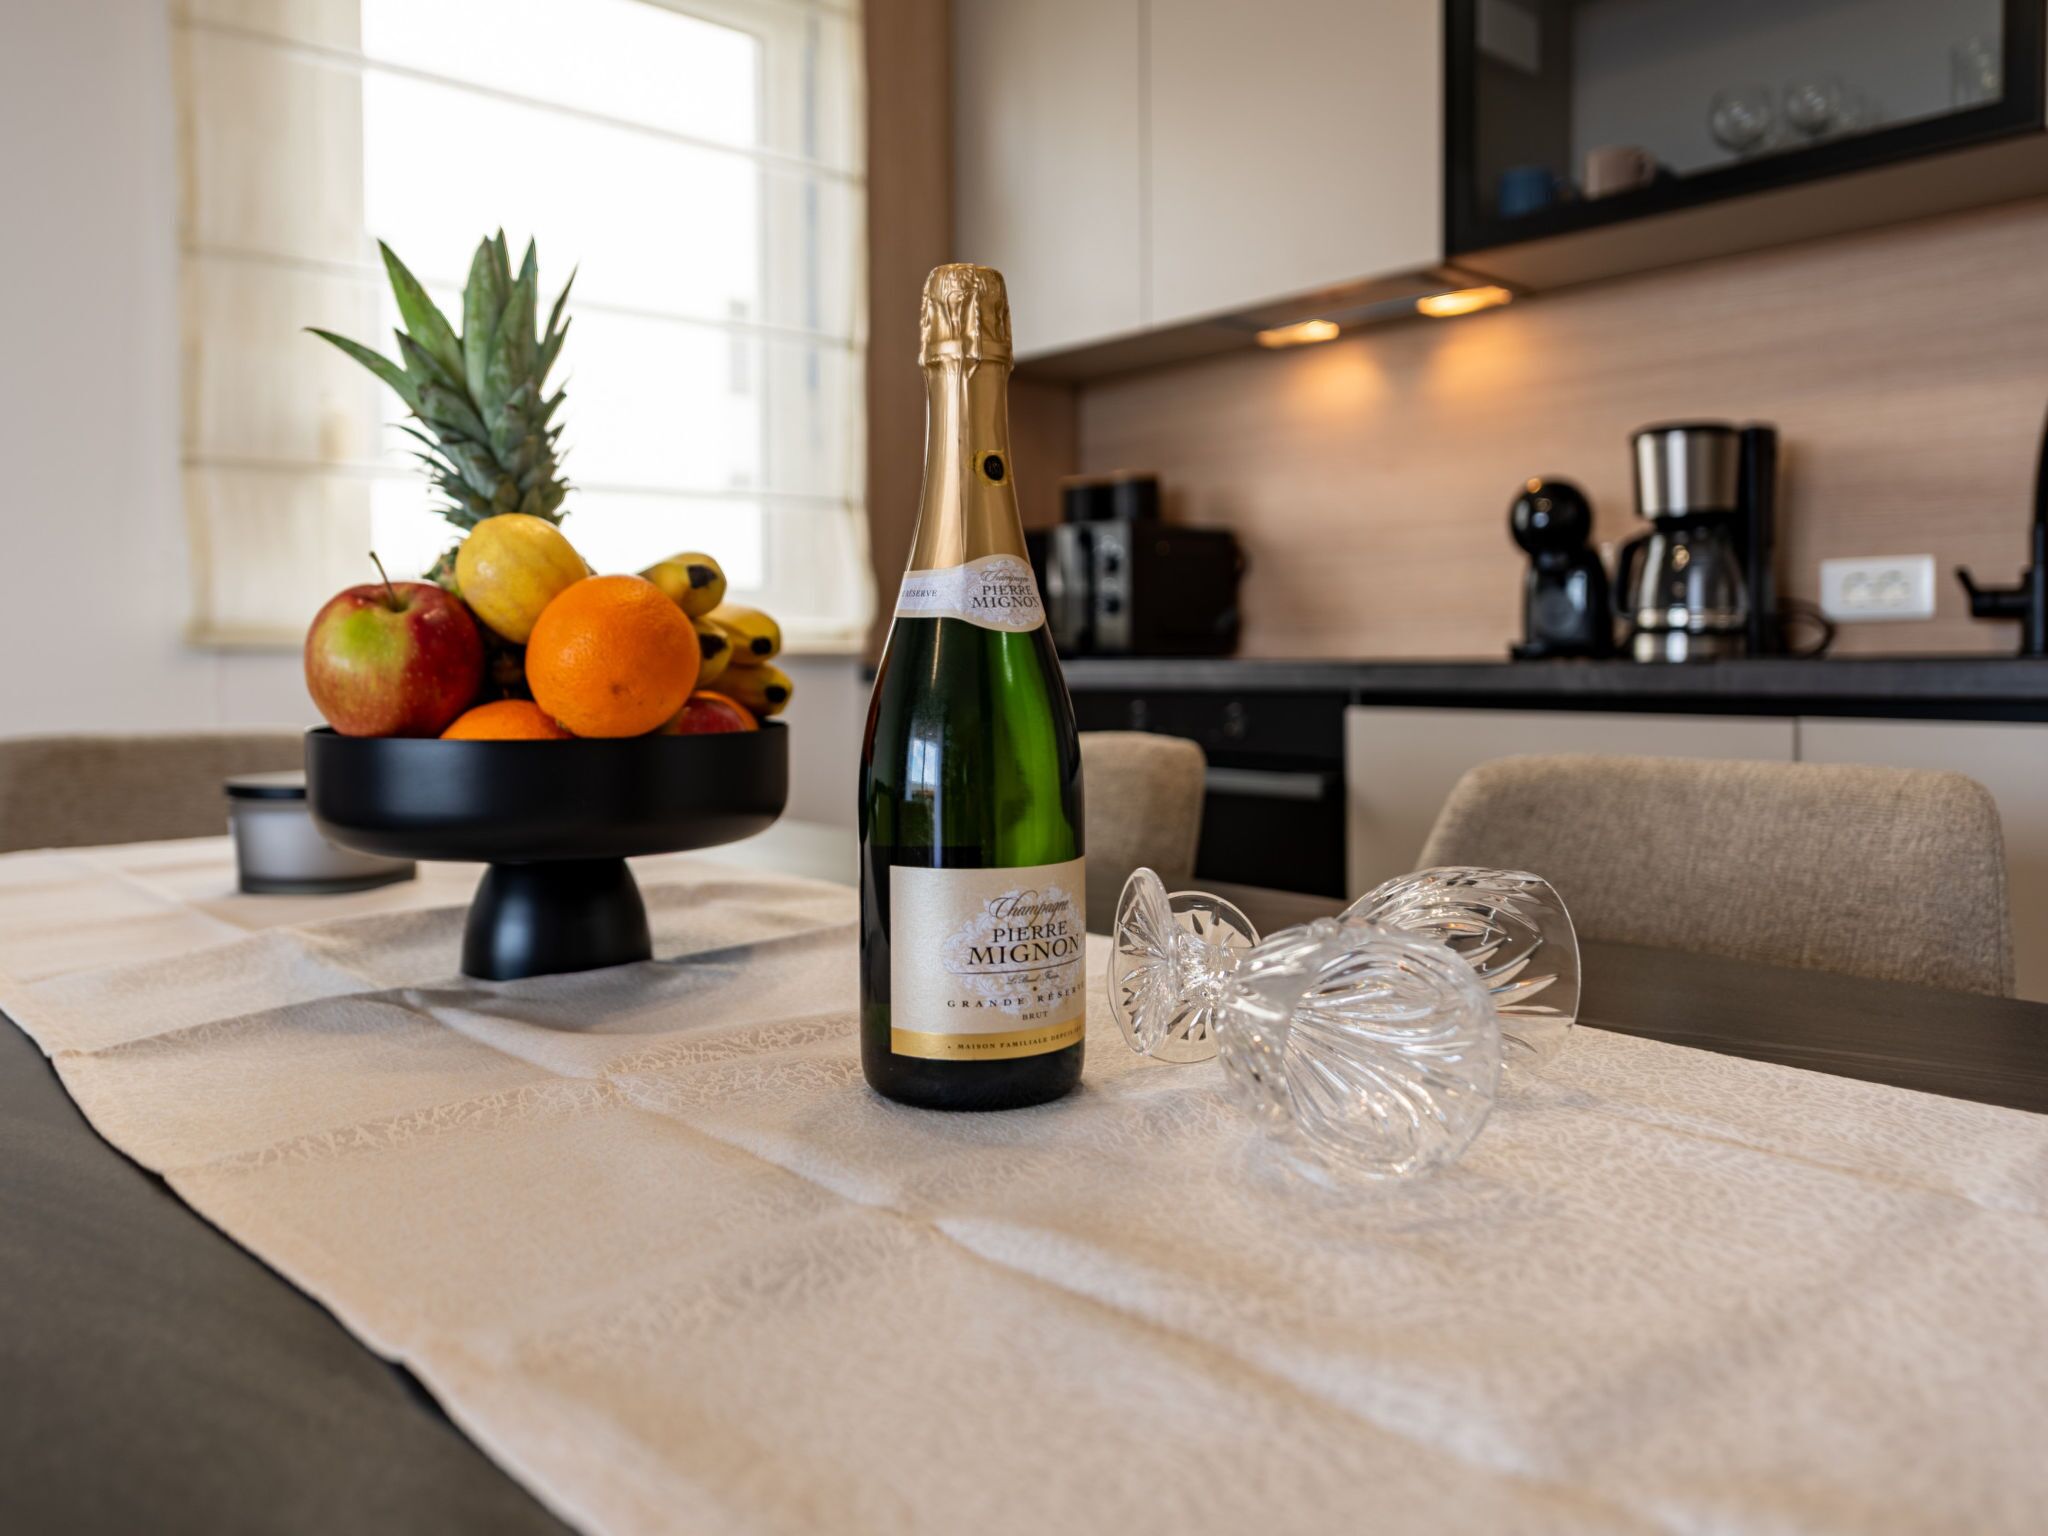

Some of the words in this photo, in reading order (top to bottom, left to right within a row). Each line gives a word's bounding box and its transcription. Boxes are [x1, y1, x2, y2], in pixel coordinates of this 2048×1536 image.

[982, 585, 1033, 596] PIERRE
[971, 596, 1039, 609] MIGNON
[989, 890, 1069, 927] Champagne
[993, 920, 1068, 943] PIERRE
[968, 933, 1079, 965] MIGNON
[947, 998, 1025, 1008] GRANDE
[1022, 1011, 1048, 1021] BRUT
[957, 1042, 995, 1050] MAISON
[1000, 1037, 1047, 1048] FAMILIALE
